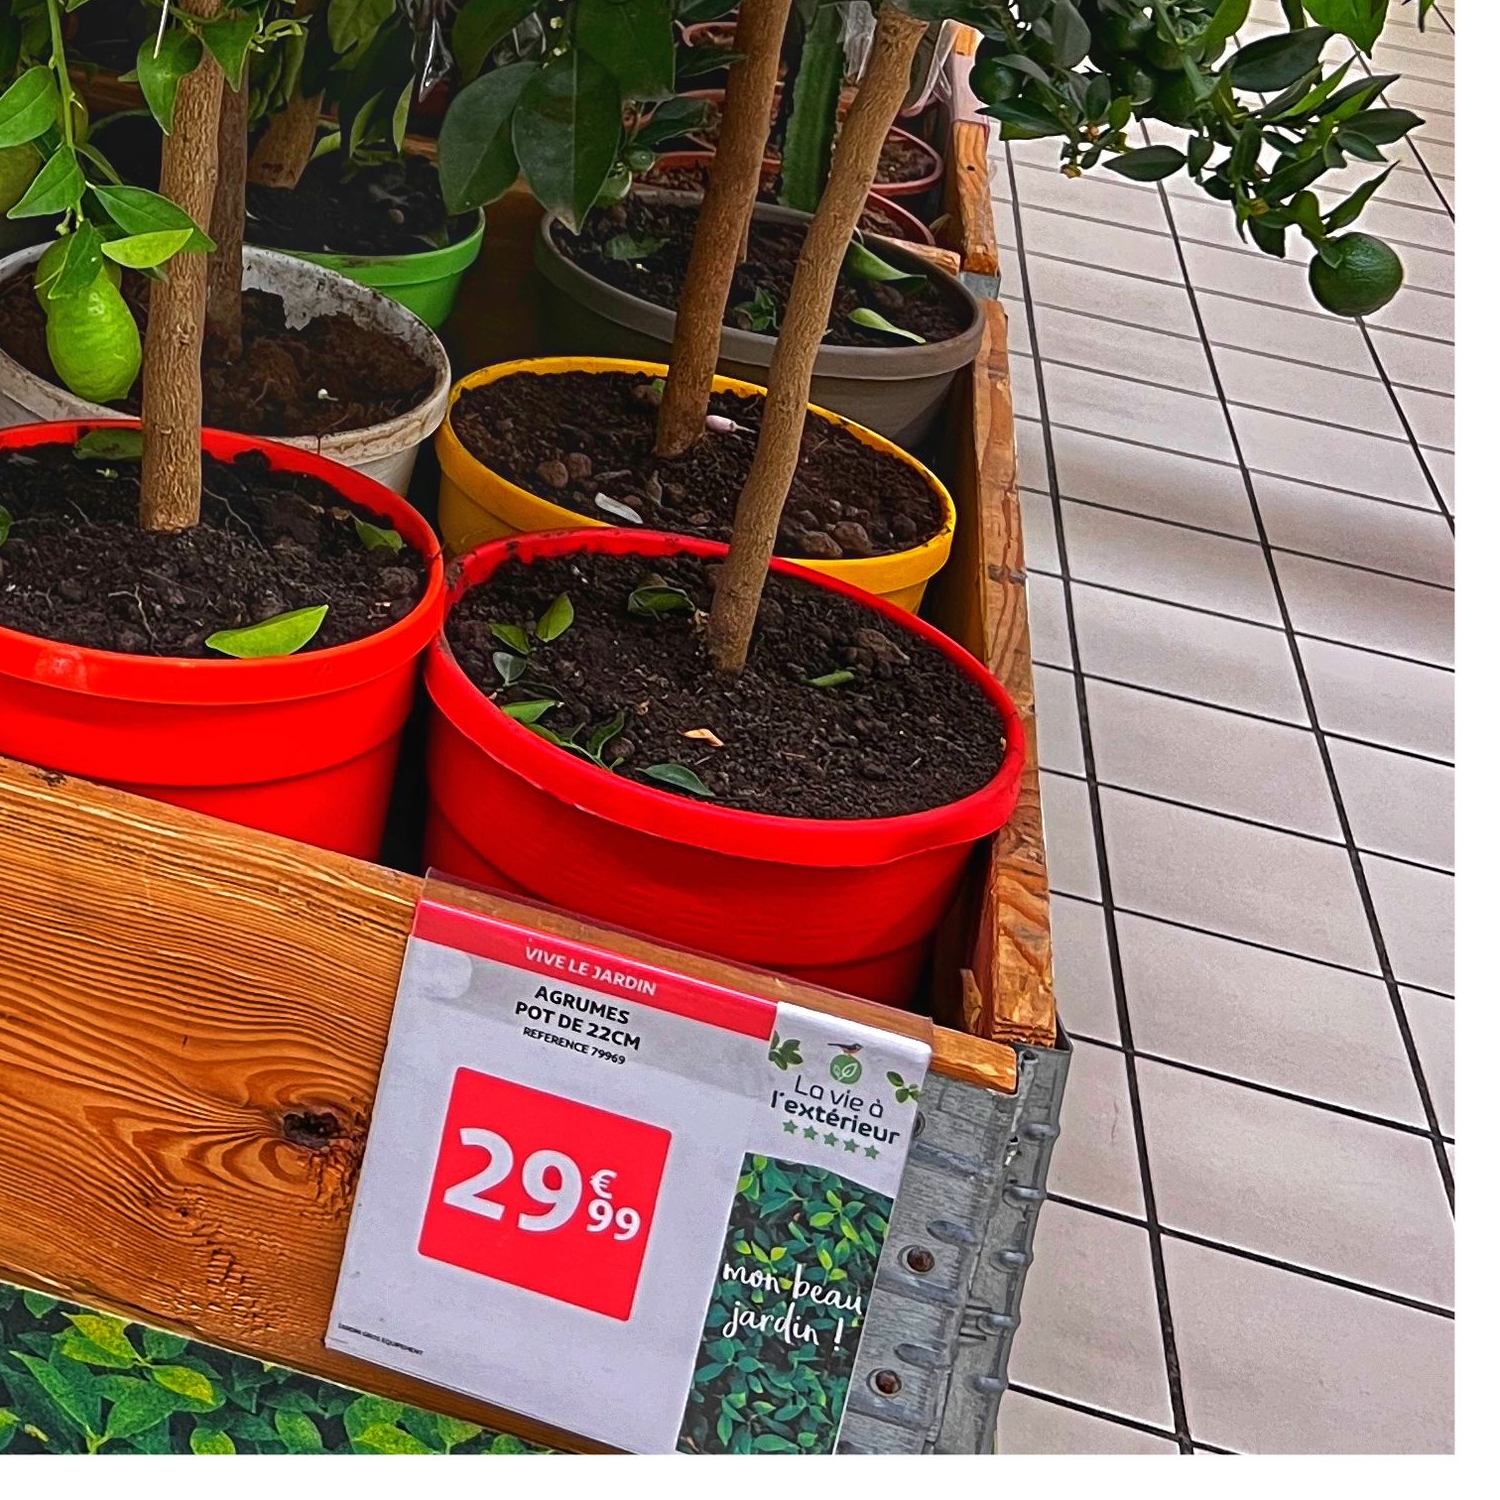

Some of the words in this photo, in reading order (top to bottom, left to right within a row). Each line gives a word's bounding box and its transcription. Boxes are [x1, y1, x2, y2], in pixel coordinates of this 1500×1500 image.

[524, 946, 567, 970] VIVE
[567, 957, 591, 978] LE
[591, 965, 658, 997] JARDIN
[514, 1000, 556, 1025] POT
[557, 1013, 585, 1034] DE
[585, 1021, 642, 1052] 22CM
[534, 985, 631, 1026] AGRUMES
[522, 1026, 591, 1055] REFERENCE
[590, 1045, 627, 1066] 79969
[770, 1089, 902, 1146] l'extérieur
[794, 1074, 825, 1101] La
[830, 1089, 865, 1113] vie
[868, 1098, 885, 1119] à
[442, 1127, 584, 1233] 29
[586, 1198, 642, 1242] 99
[722, 1262, 781, 1295] mon
[791, 1262, 863, 1316] beau
[722, 1299, 820, 1347] jardin
